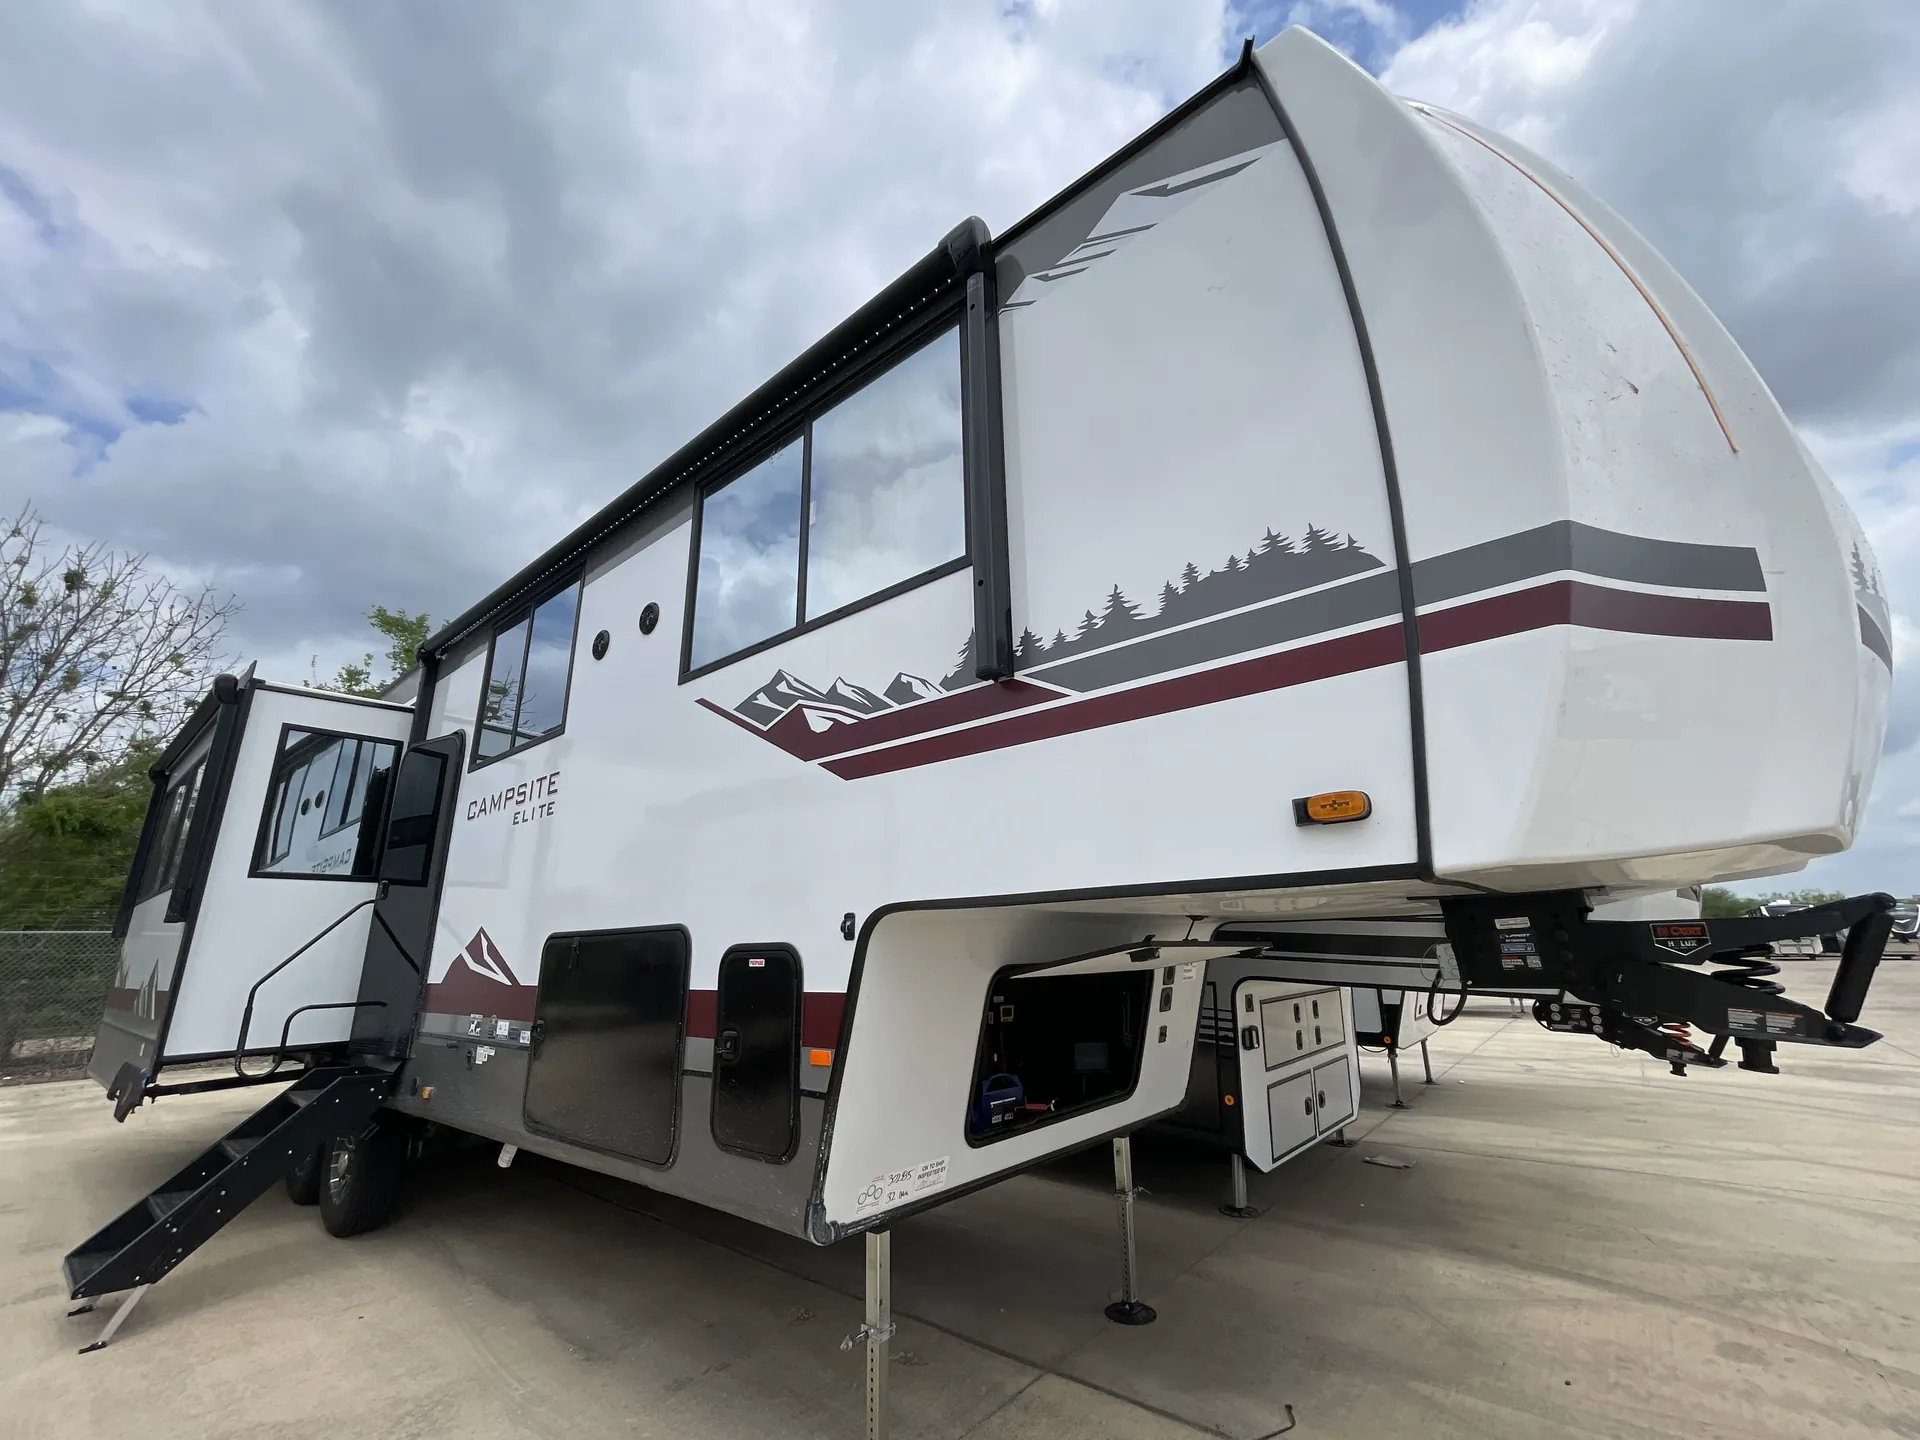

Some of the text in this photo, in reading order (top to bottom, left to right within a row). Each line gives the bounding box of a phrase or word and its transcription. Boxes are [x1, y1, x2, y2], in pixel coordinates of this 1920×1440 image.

[467, 770, 560, 821] CAMPSITE
[512, 801, 556, 826] ELITE
[917, 1168, 940, 1180] INSPECTED
